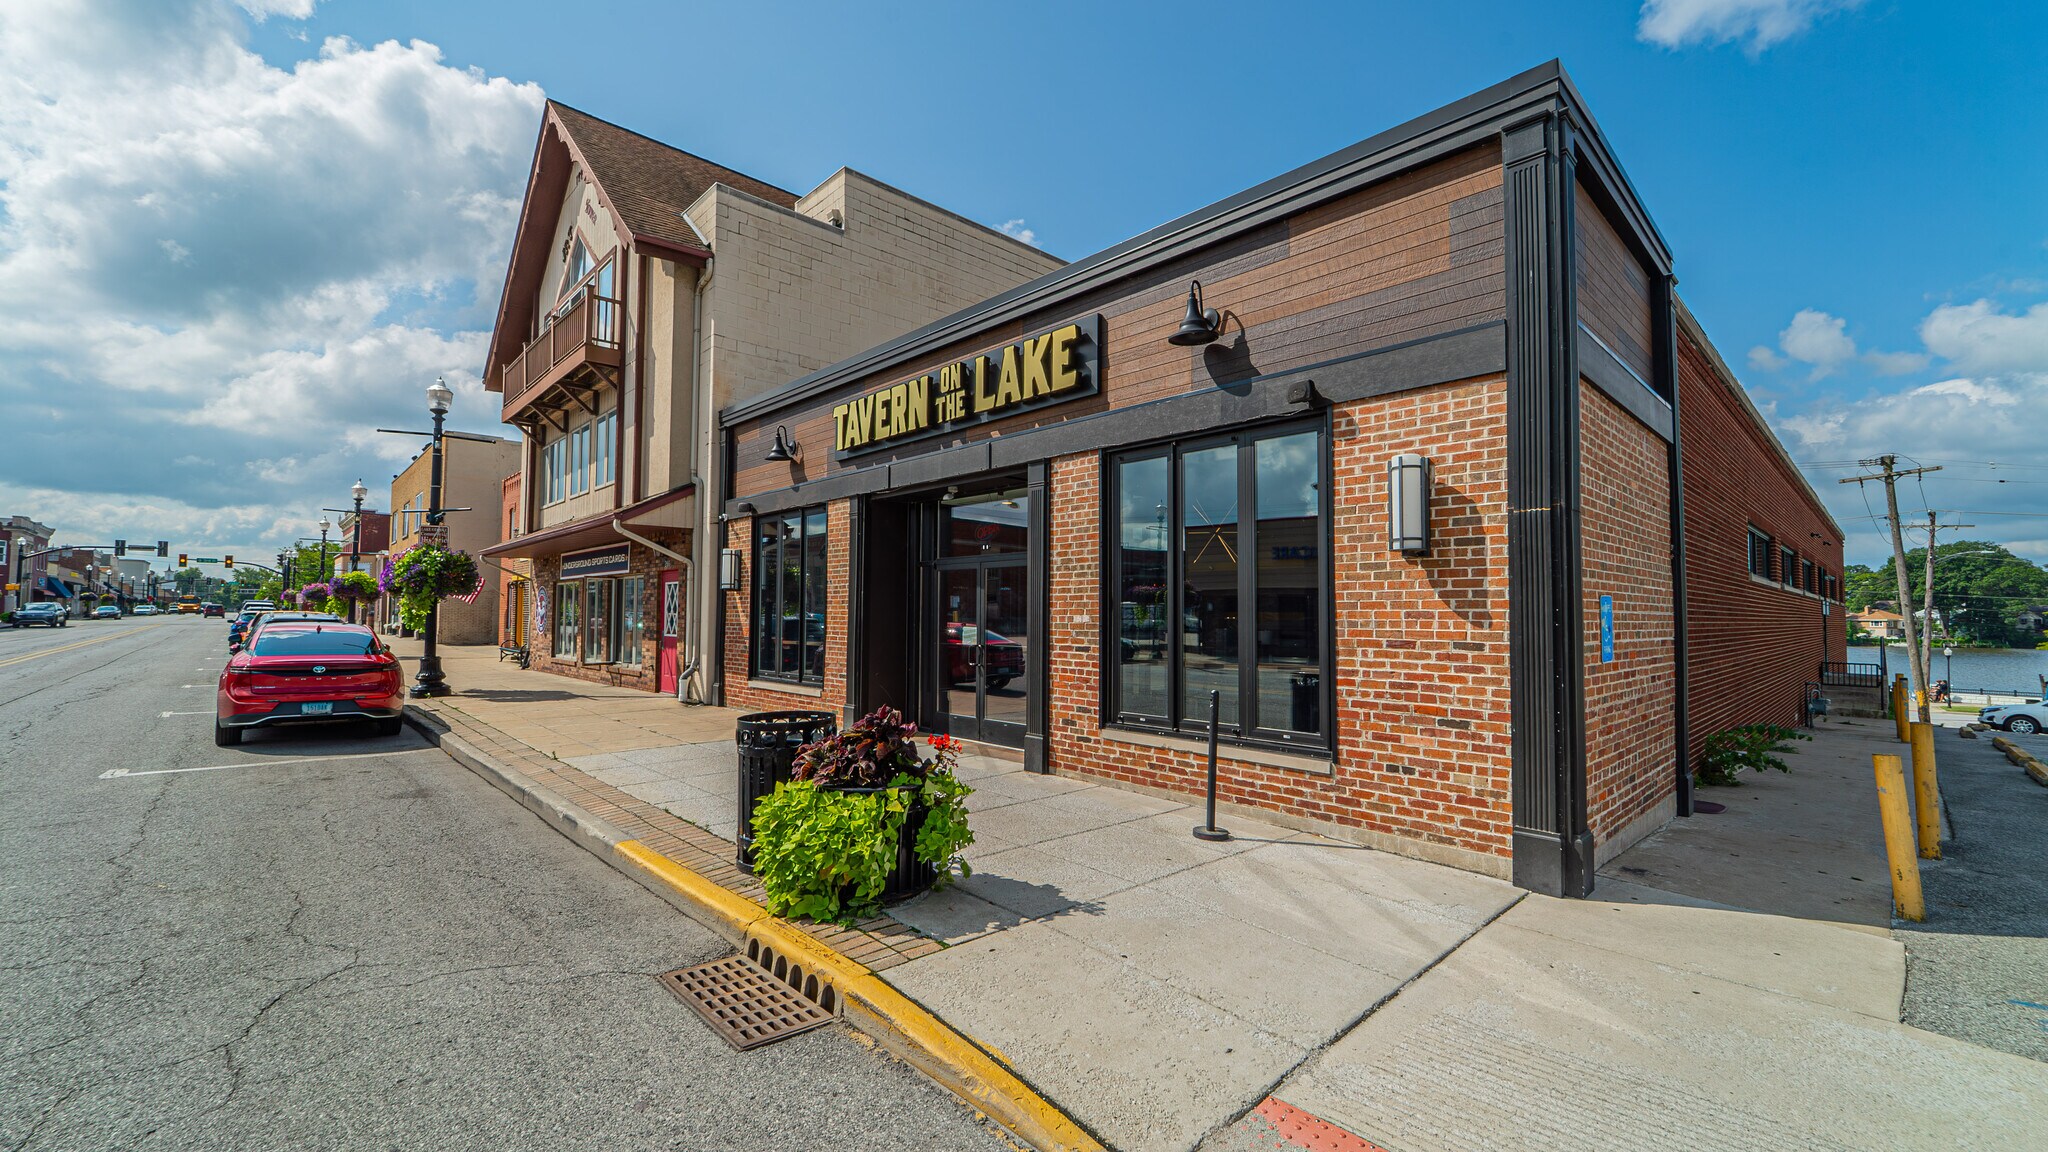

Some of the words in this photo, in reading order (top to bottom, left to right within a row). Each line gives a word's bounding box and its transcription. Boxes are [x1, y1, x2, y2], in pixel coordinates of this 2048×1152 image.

[940, 362, 961, 394] ON
[974, 324, 1078, 413] LAKE
[833, 376, 930, 451] TAVERN
[935, 390, 965, 423] THE
[563, 559, 591, 570] UNDERGROUND
[592, 556, 608, 566] SPORTS
[609, 554, 625, 563] CARDS
